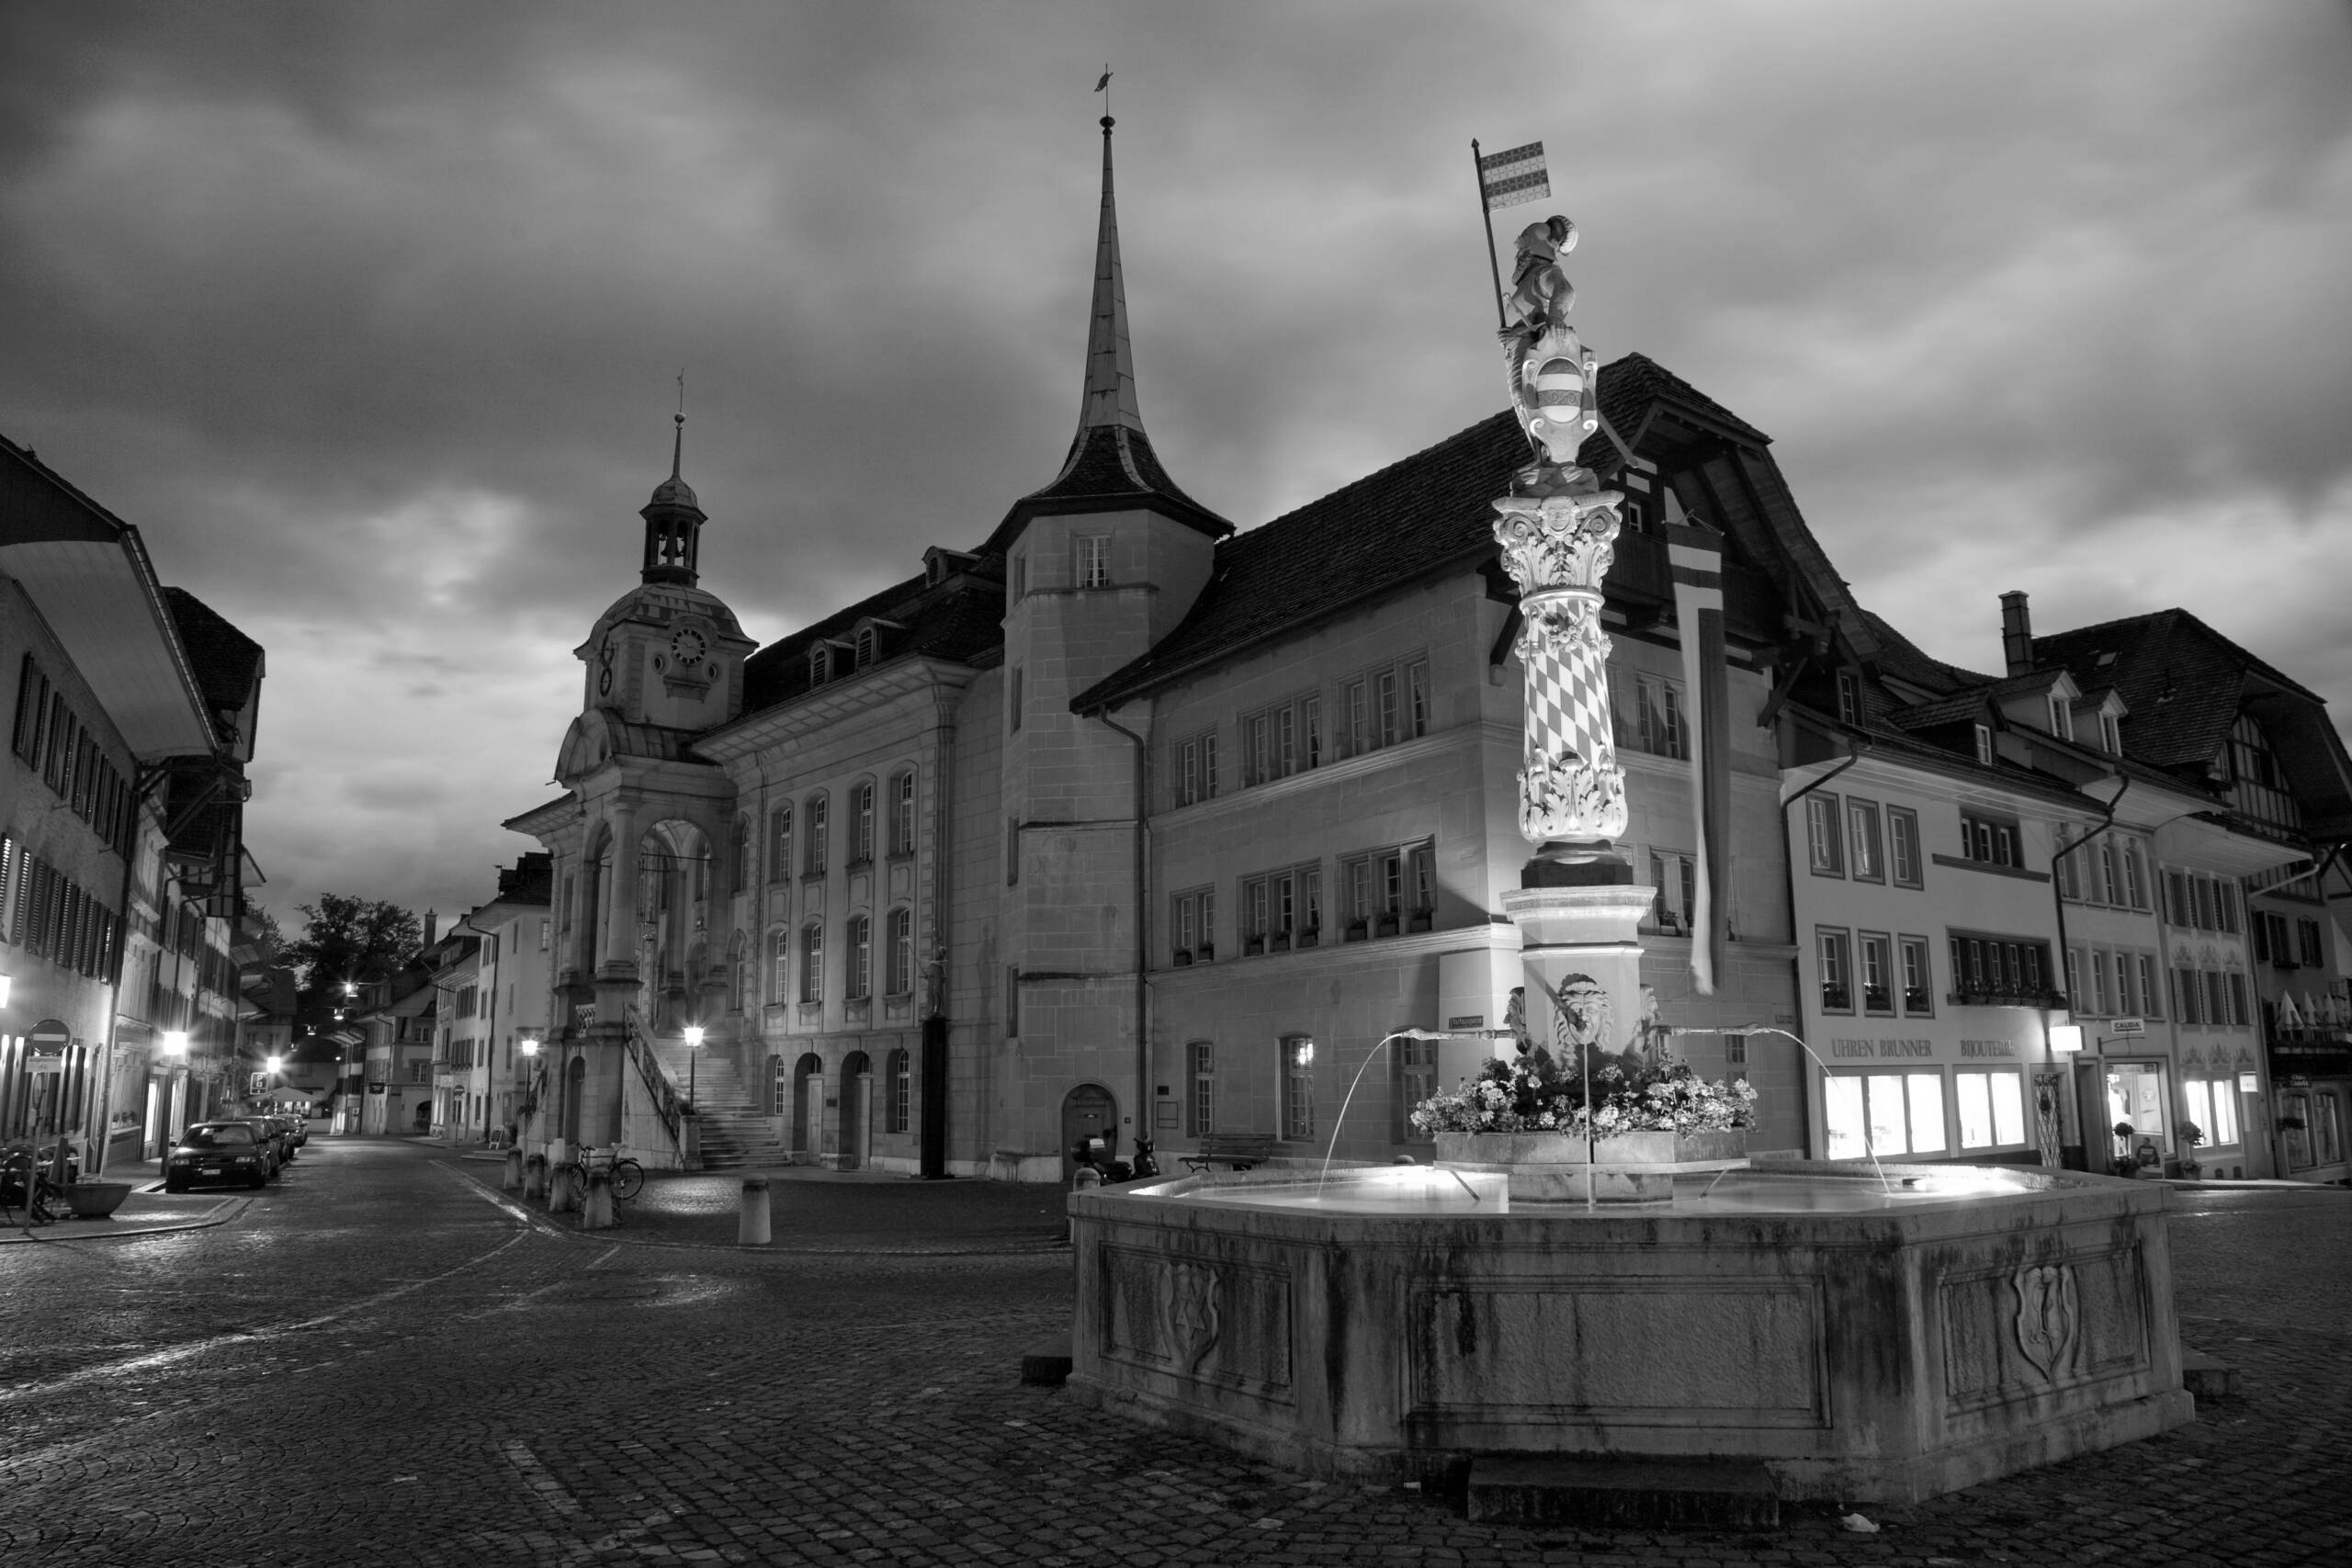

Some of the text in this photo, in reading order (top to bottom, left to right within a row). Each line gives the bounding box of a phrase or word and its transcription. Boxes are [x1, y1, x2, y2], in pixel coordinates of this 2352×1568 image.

[1831, 1039, 1932, 1057] UHREN BRUNNER
[1960, 1039, 2014, 1058] BIJOUTERIE
